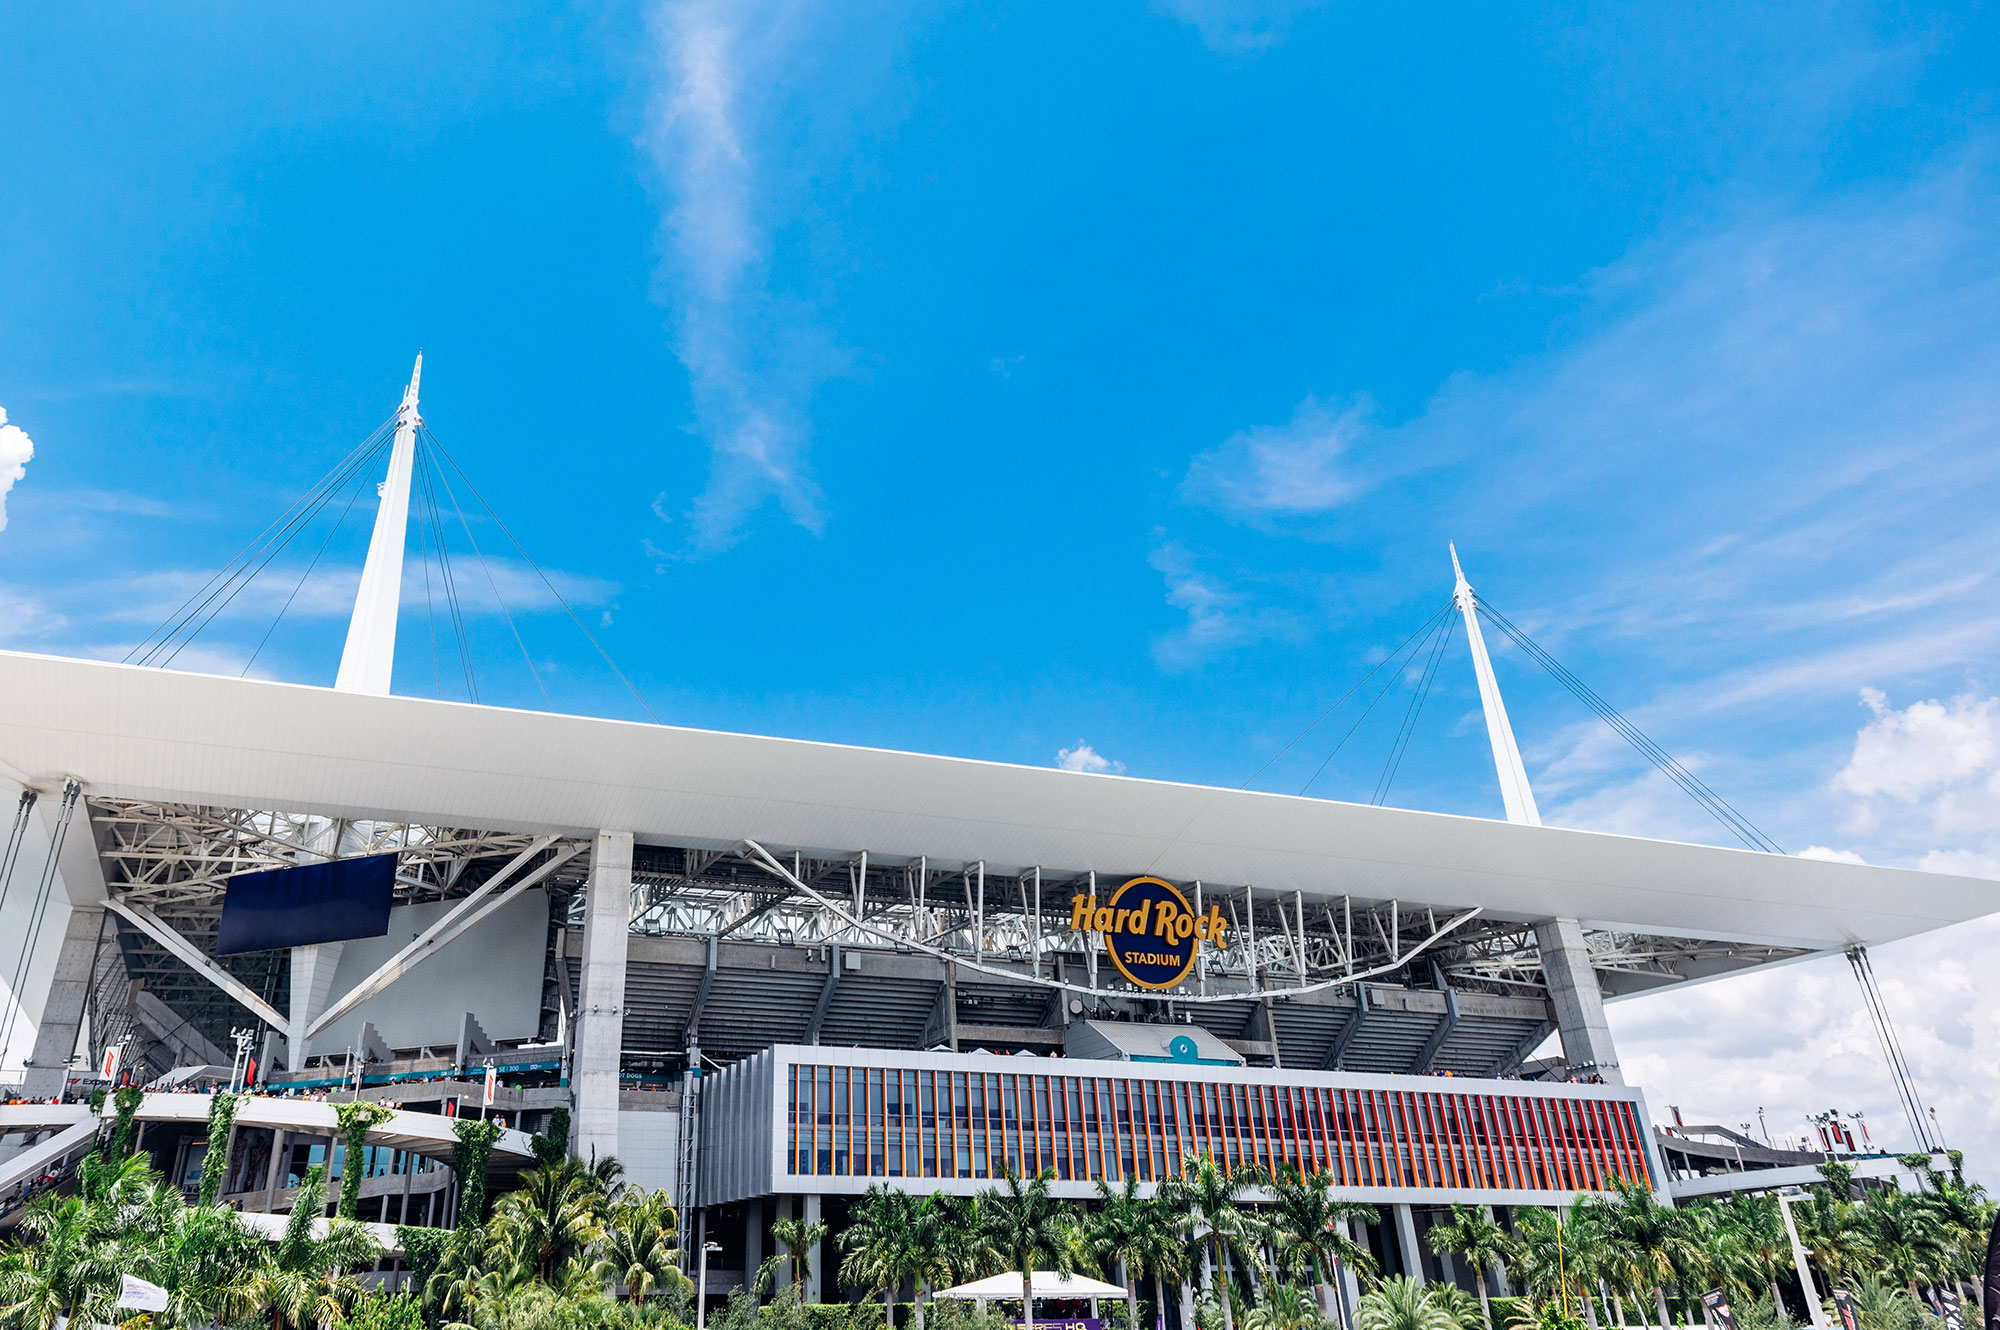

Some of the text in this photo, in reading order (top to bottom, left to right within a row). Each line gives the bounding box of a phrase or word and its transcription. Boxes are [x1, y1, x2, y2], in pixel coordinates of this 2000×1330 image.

[1070, 893, 1228, 949] Hard Rock
[1124, 951, 1181, 967] STADIUM
[1065, 1322, 1087, 1330] HQ
